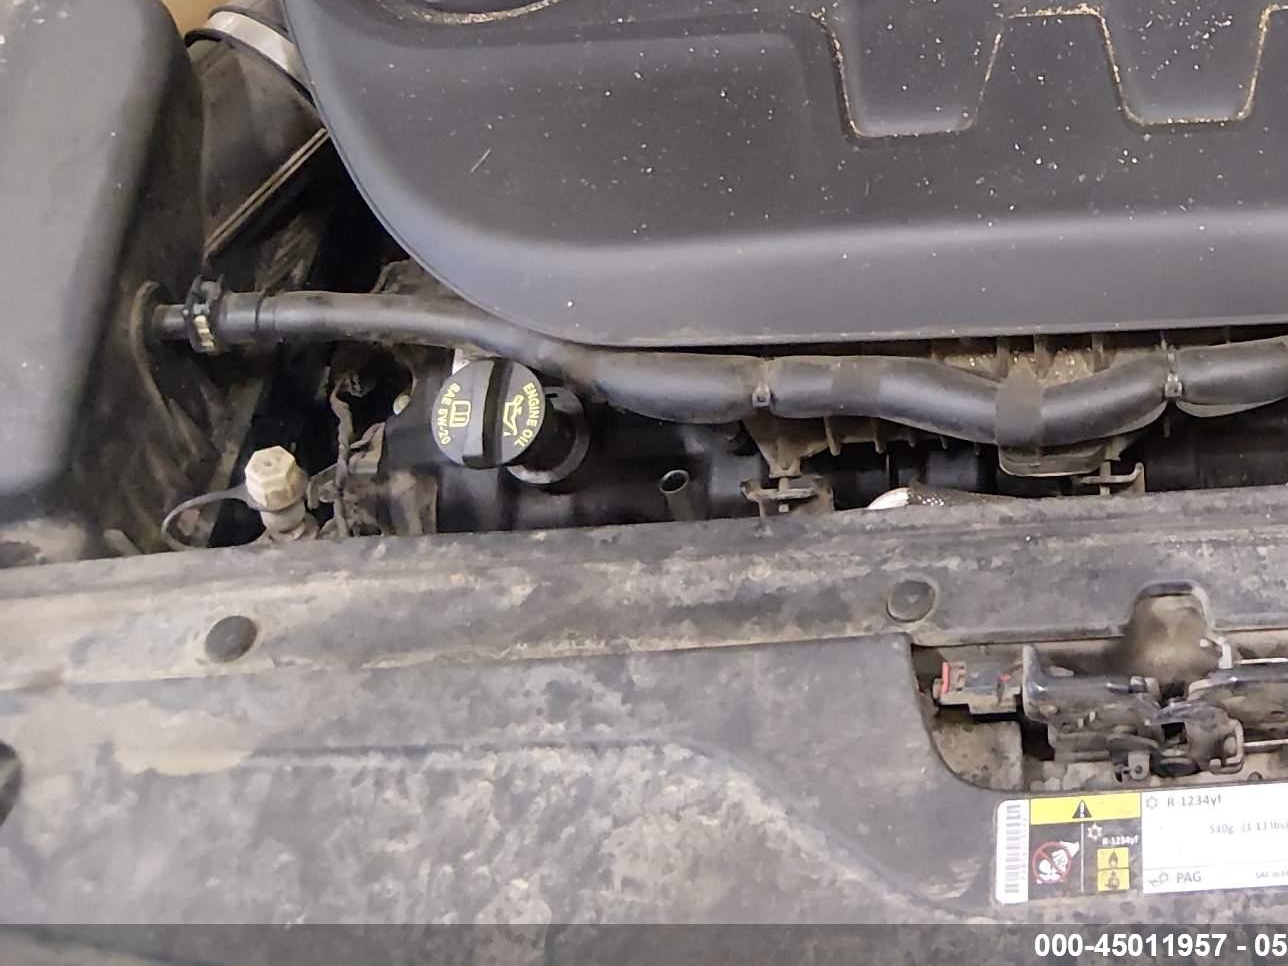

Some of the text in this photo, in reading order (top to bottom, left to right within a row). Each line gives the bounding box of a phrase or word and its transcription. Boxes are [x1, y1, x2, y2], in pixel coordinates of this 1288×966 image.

[441, 382, 460, 405] SAE
[513, 381, 540, 447] ENGINE OIL
[1176, 871, 1202, 884] PAG
